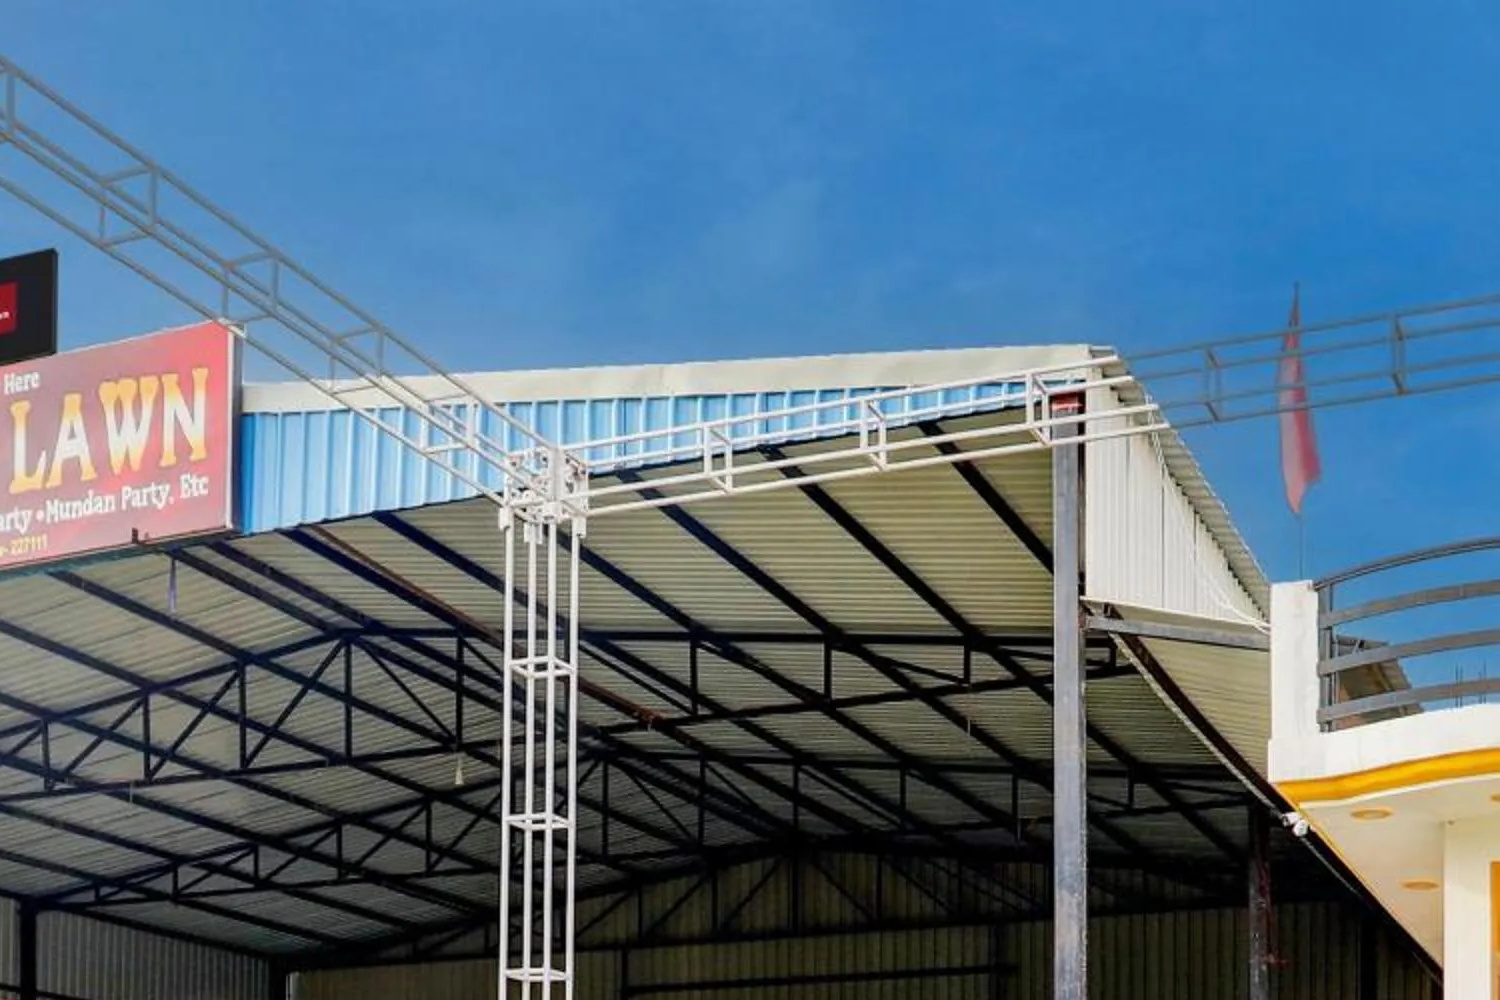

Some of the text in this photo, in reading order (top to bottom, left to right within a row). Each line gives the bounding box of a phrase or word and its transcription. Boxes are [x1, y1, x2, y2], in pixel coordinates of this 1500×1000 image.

[4, 371, 40, 392] Here
[8, 368, 208, 494] LAWN
[45, 489, 116, 525] Mundan
[179, 473, 209, 499] Etc
